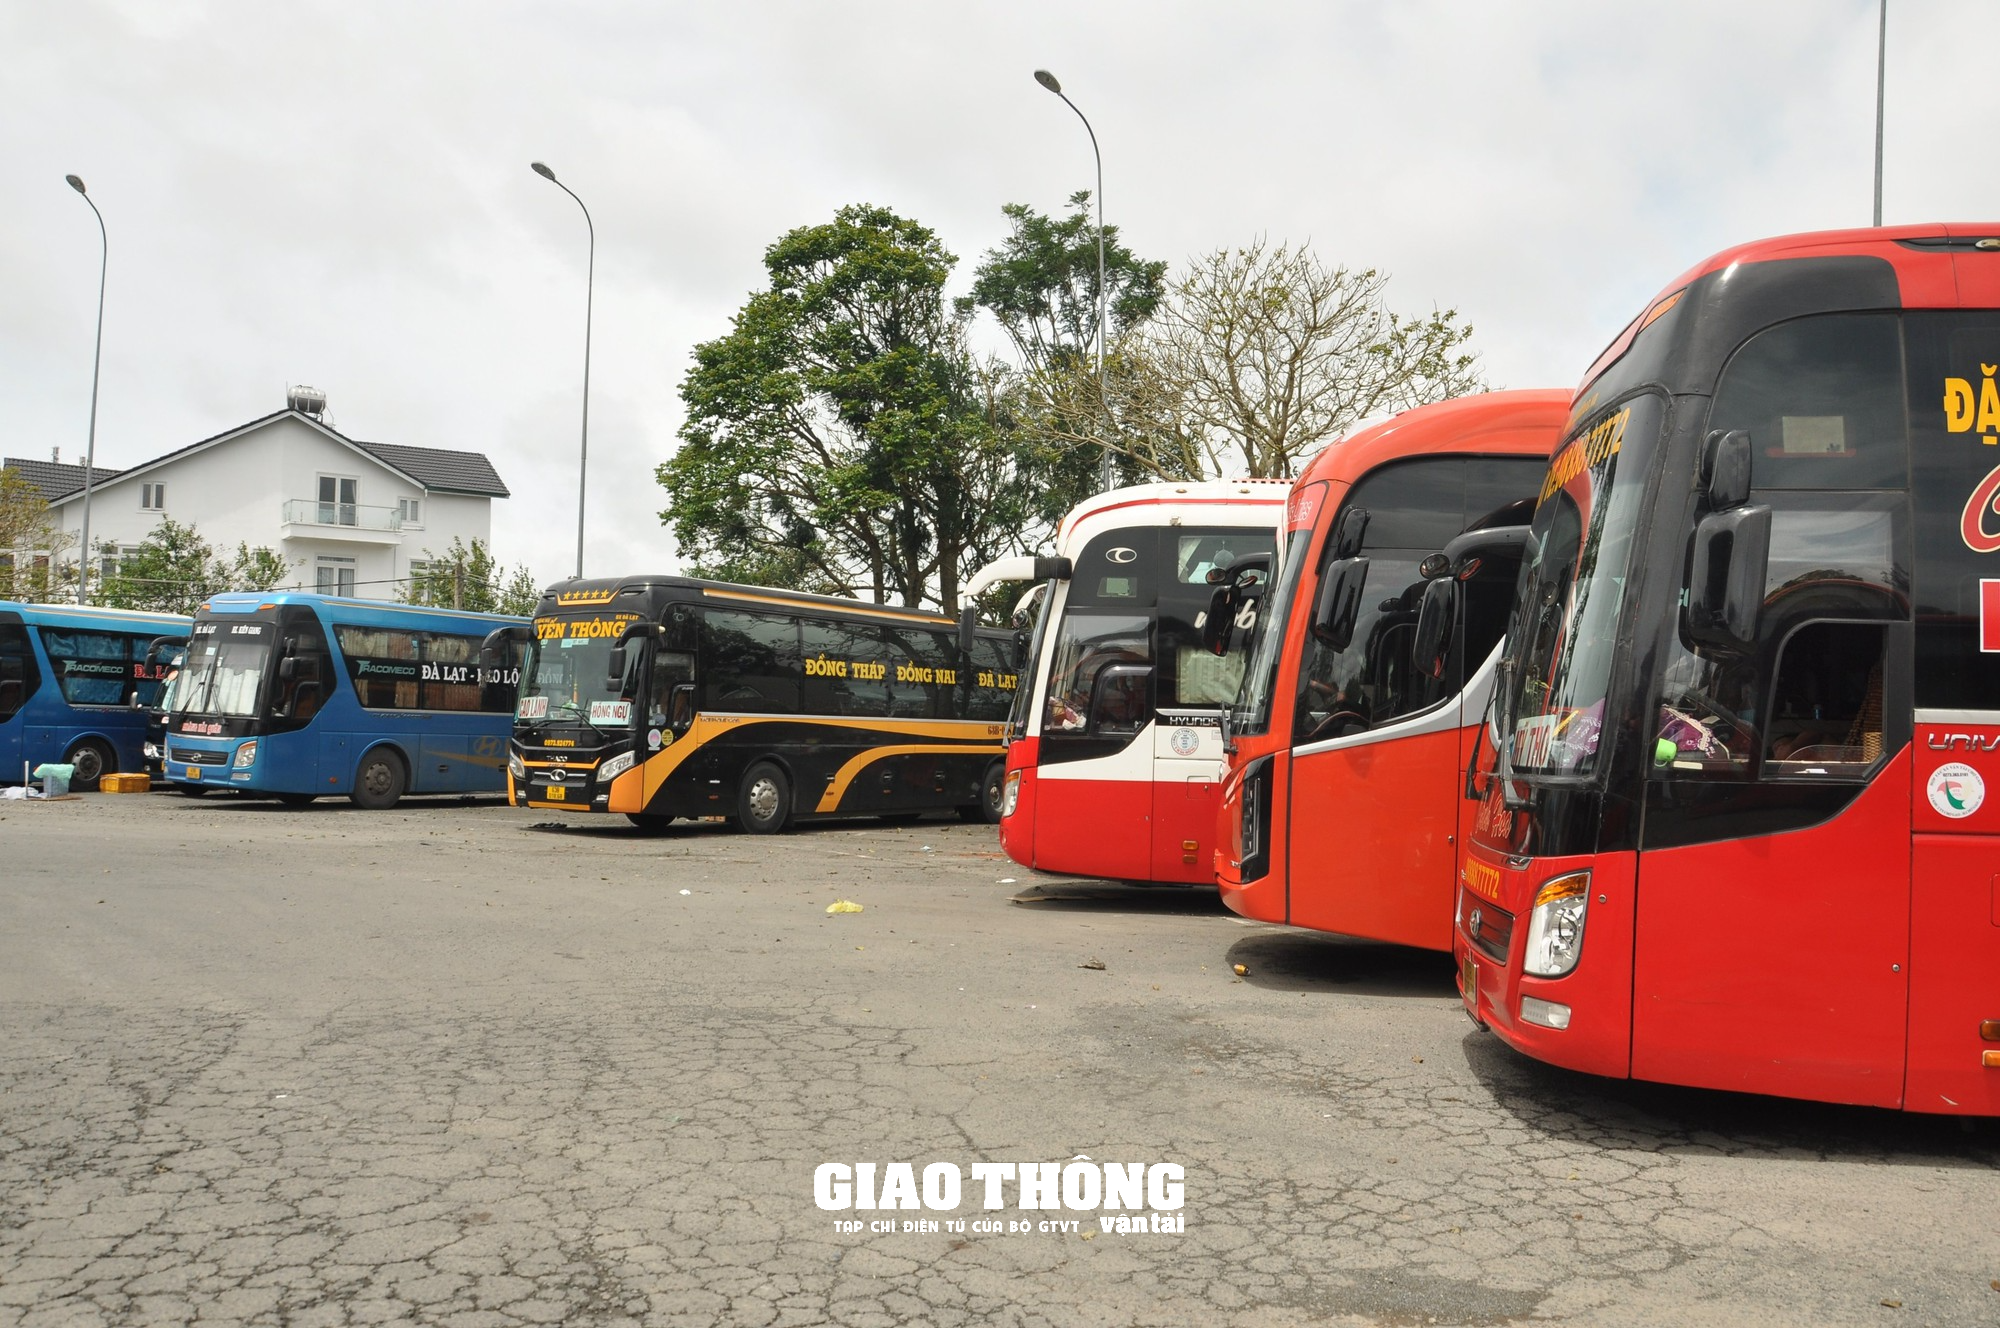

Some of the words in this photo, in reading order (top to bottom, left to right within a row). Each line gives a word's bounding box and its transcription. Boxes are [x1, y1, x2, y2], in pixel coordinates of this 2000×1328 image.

[537, 618, 567, 640] YẾN
[570, 617, 626, 638] THÔNG
[63, 661, 124, 675] TRACOMECO
[356, 660, 416, 675] TRACOMECO
[422, 661, 440, 680] ĐÀ
[443, 666, 468, 684] LẠT
[806, 653, 847, 677] ĐỒNG
[852, 660, 886, 680] THÁP
[897, 660, 932, 683] ĐỒNG
[936, 669, 956, 684] NAI
[503, 667, 521, 688] LỘ
[979, 669, 994, 687] ĐÀ
[998, 674, 1017, 690] LẠT
[1169, 716, 1220, 726] HYUNDA
